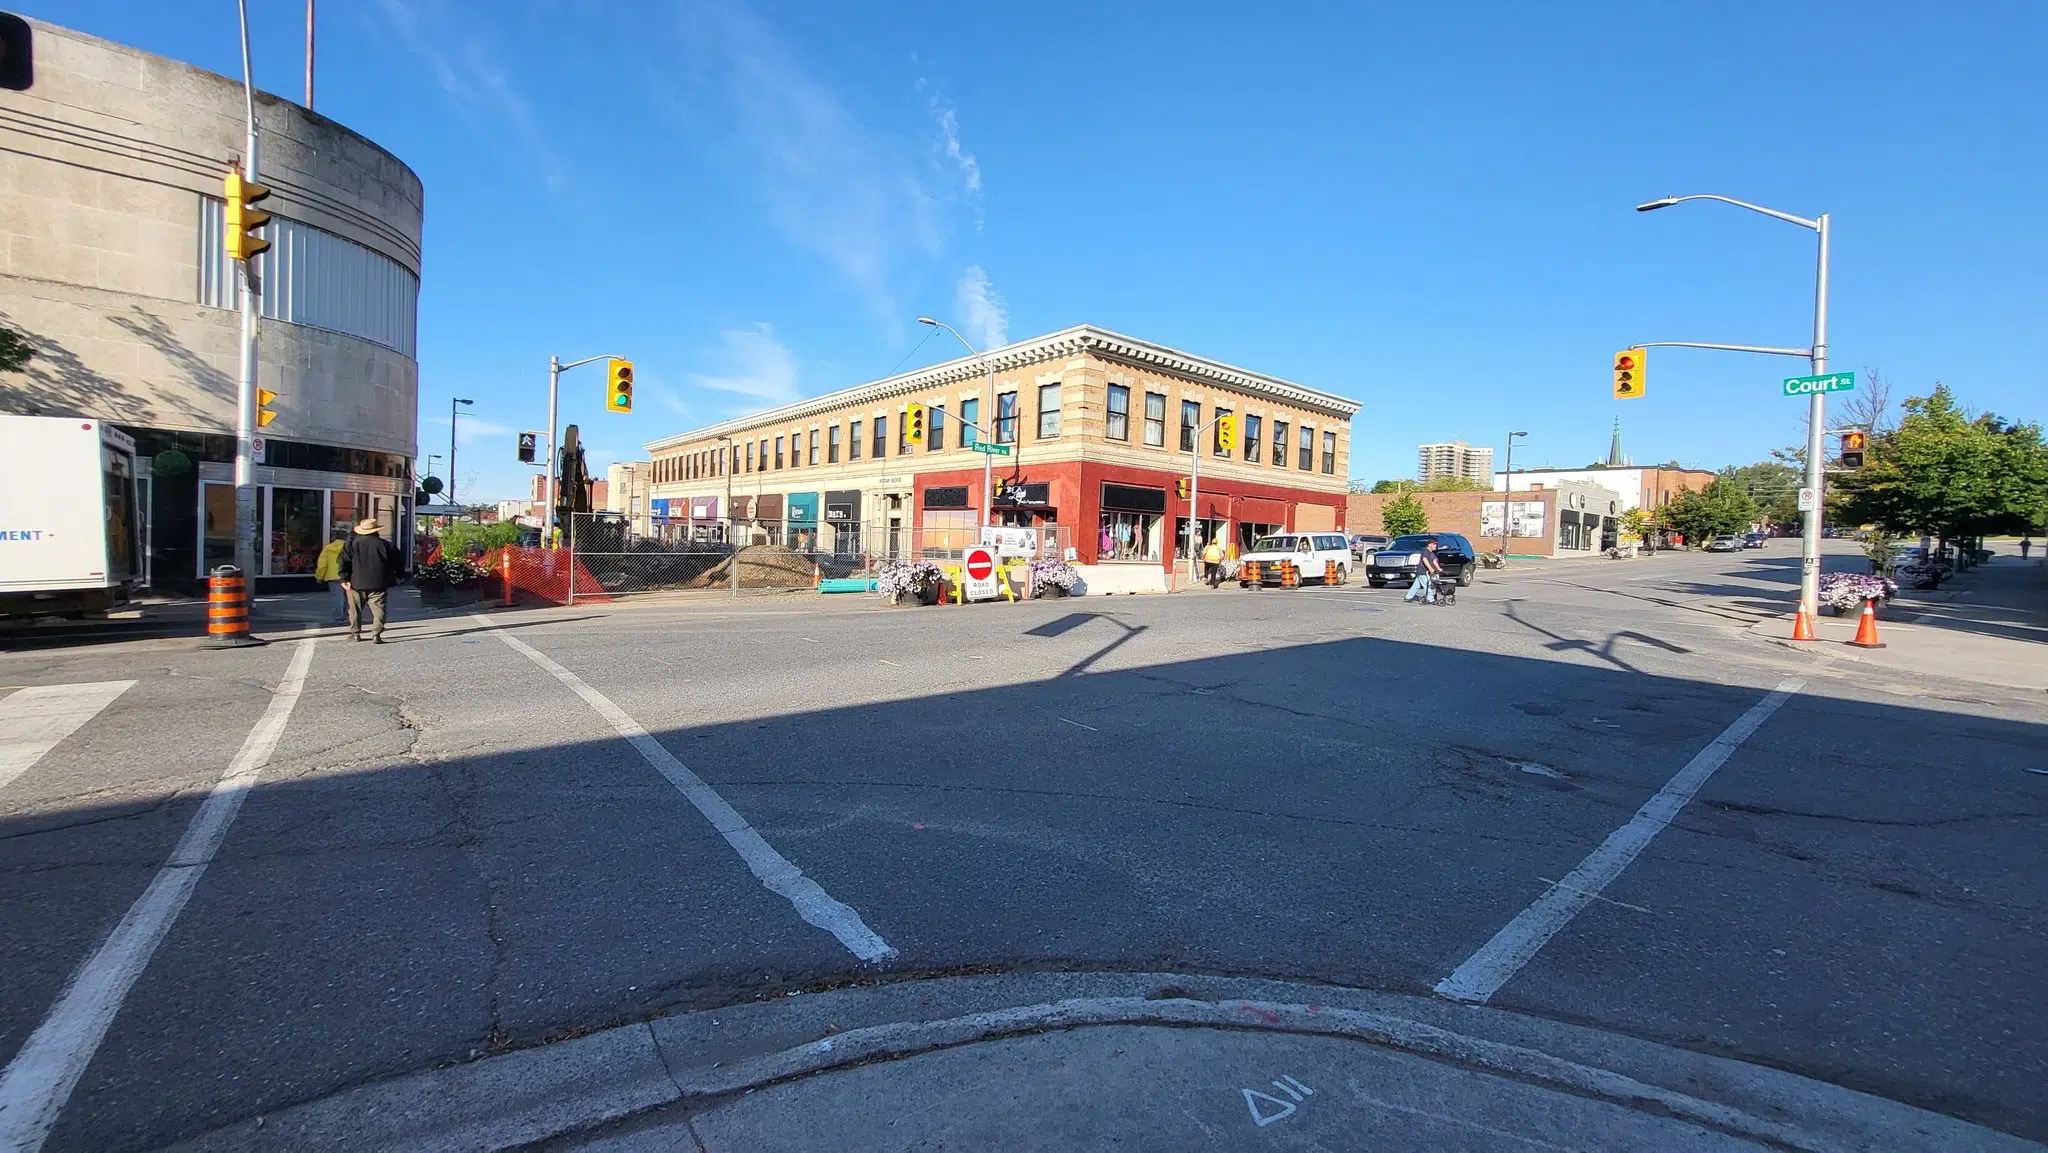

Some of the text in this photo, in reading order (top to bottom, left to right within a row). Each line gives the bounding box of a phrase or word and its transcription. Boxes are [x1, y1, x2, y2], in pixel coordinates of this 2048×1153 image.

[1785, 376, 1838, 394] Court
[974, 443, 986, 452] Red
[986, 445, 1000, 454] River
